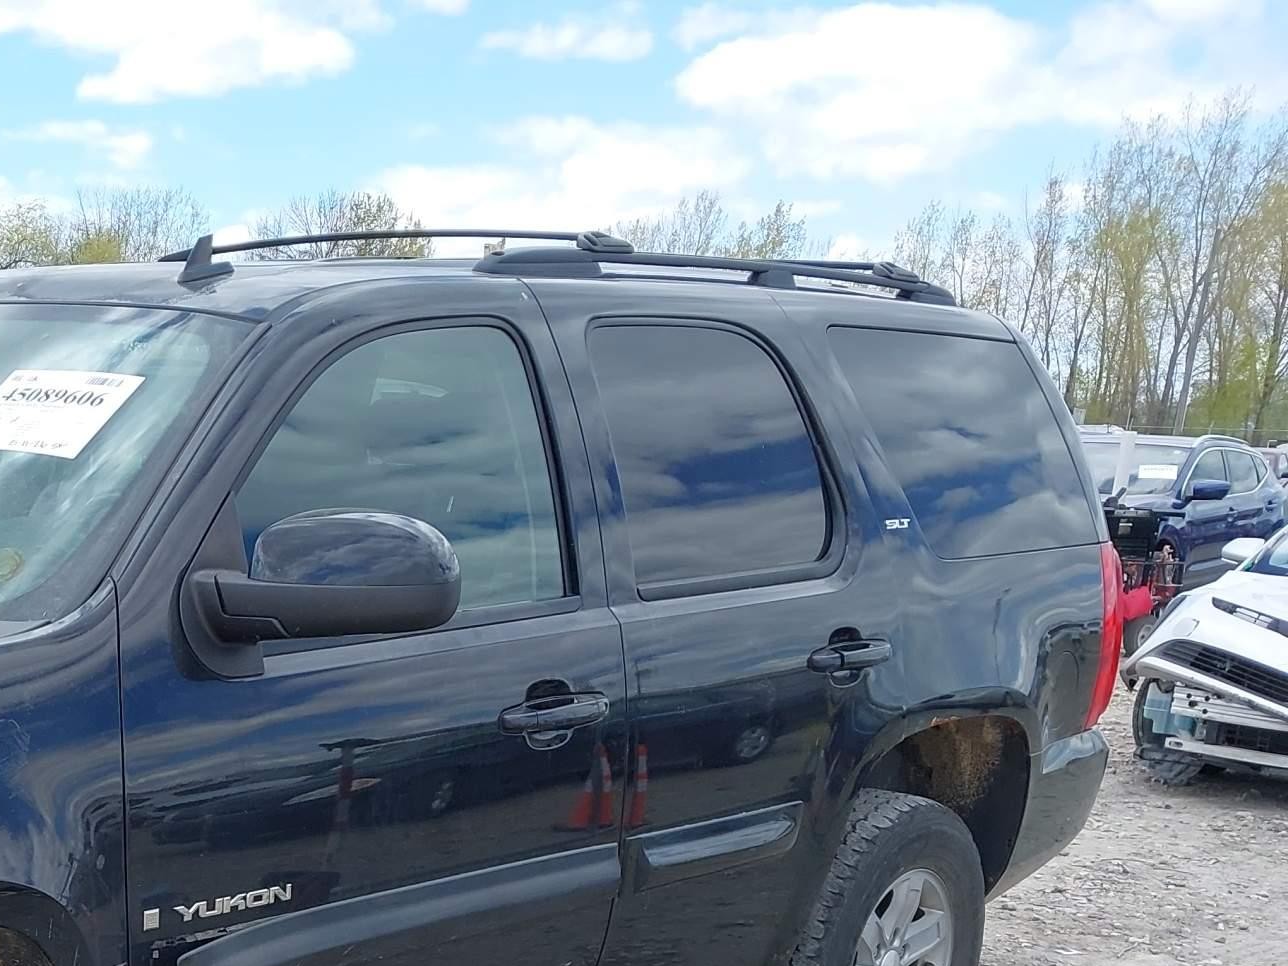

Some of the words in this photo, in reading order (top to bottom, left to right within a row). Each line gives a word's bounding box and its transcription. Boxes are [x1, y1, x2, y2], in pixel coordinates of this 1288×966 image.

[1, 387, 108, 408] 45089606
[885, 518, 911, 530] SLT
[173, 883, 293, 922] YUKON
